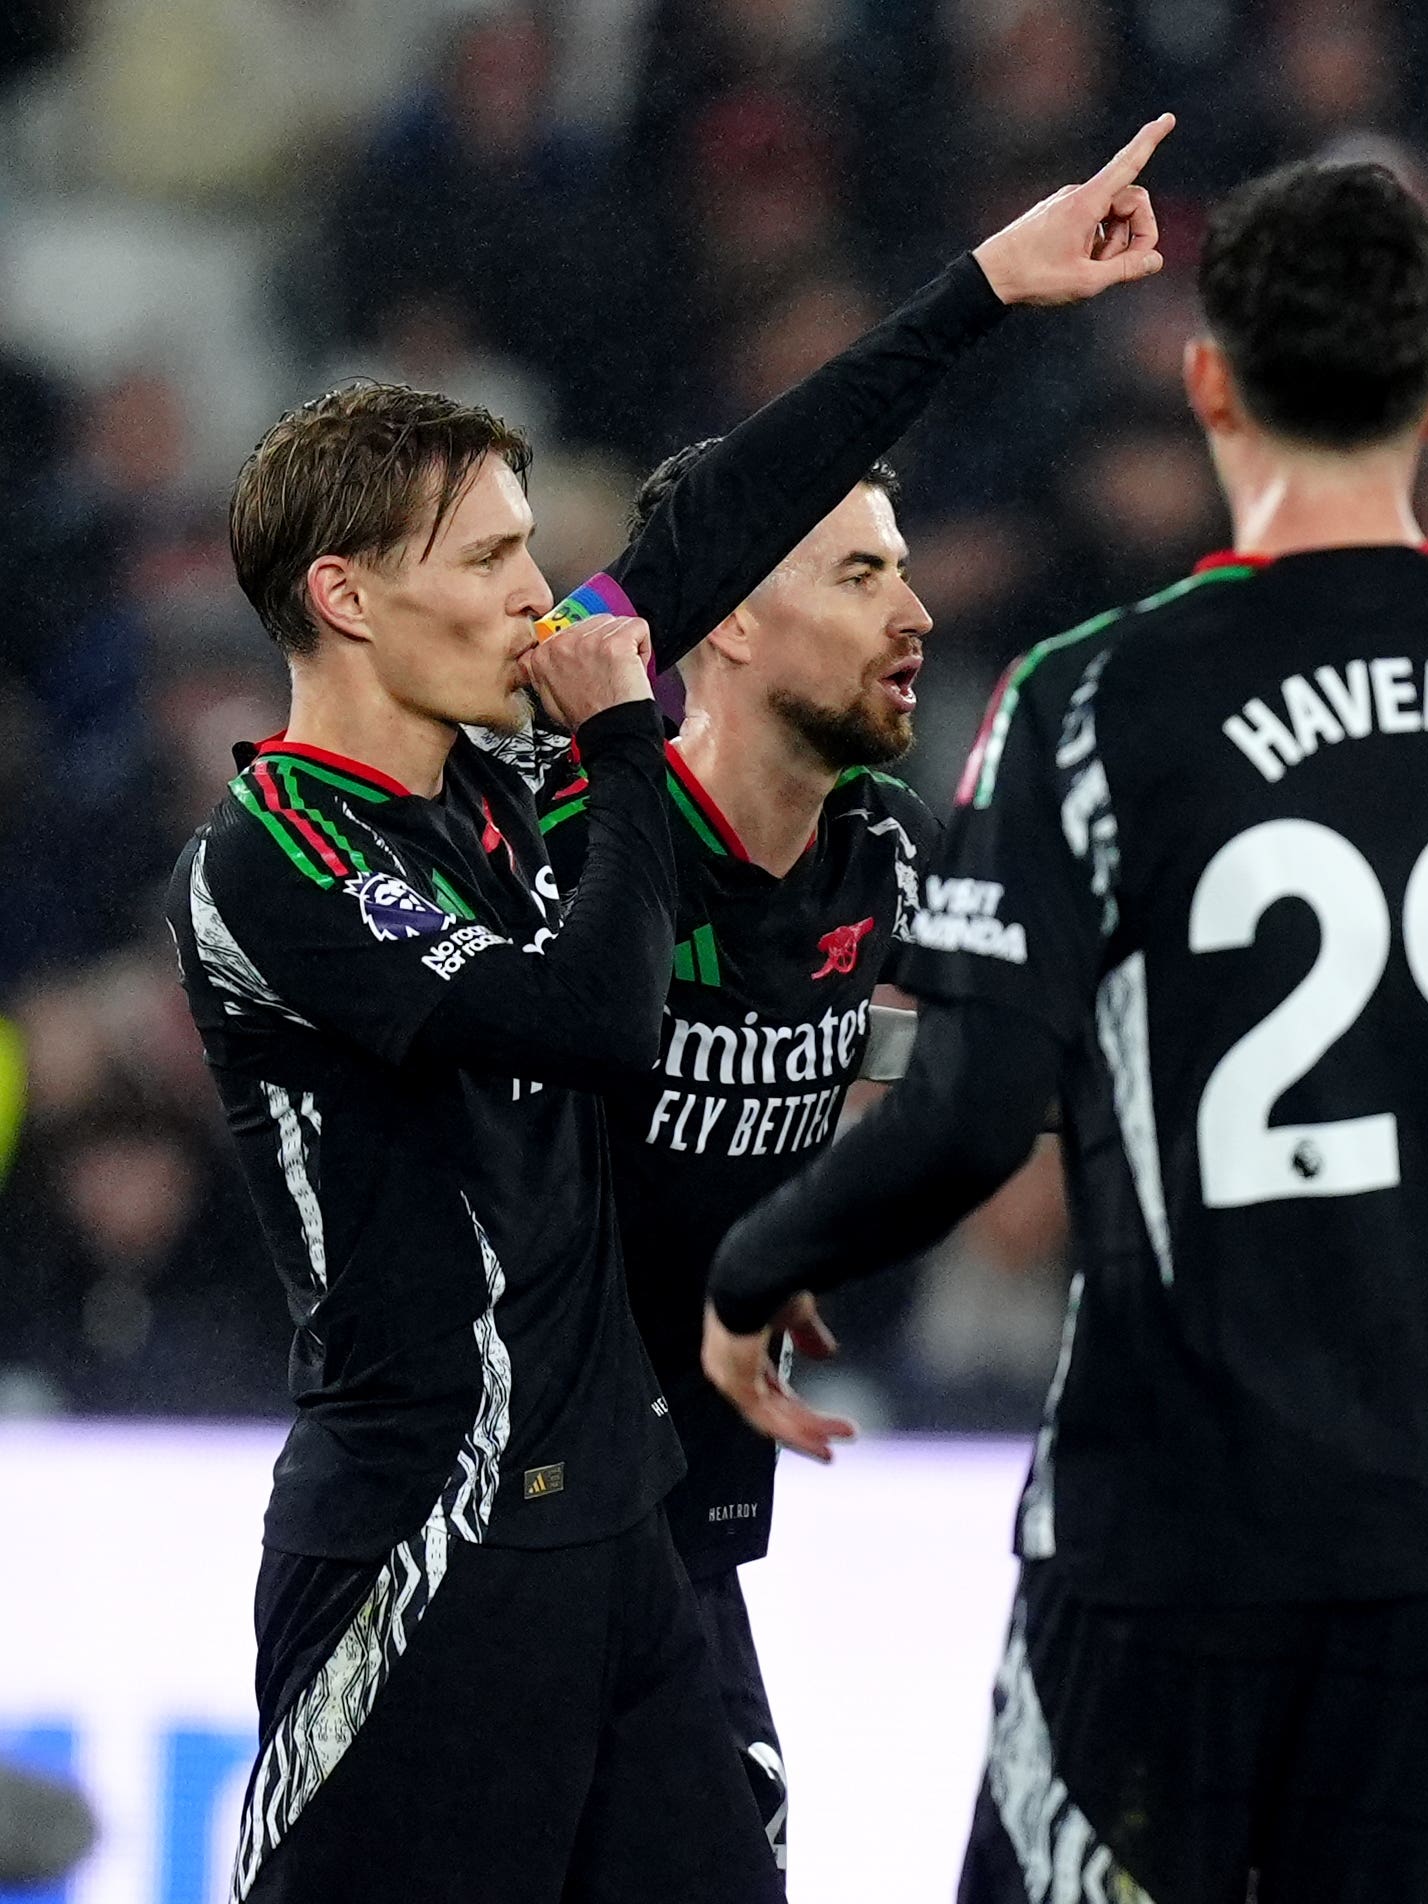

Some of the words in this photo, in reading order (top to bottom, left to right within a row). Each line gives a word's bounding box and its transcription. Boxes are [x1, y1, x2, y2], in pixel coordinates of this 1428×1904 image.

[926, 874, 1005, 918] VISIT
[421, 941, 455, 971] No
[645, 1090, 727, 1154] FLY
[708, 1503, 758, 1522] HEAT.RDY
